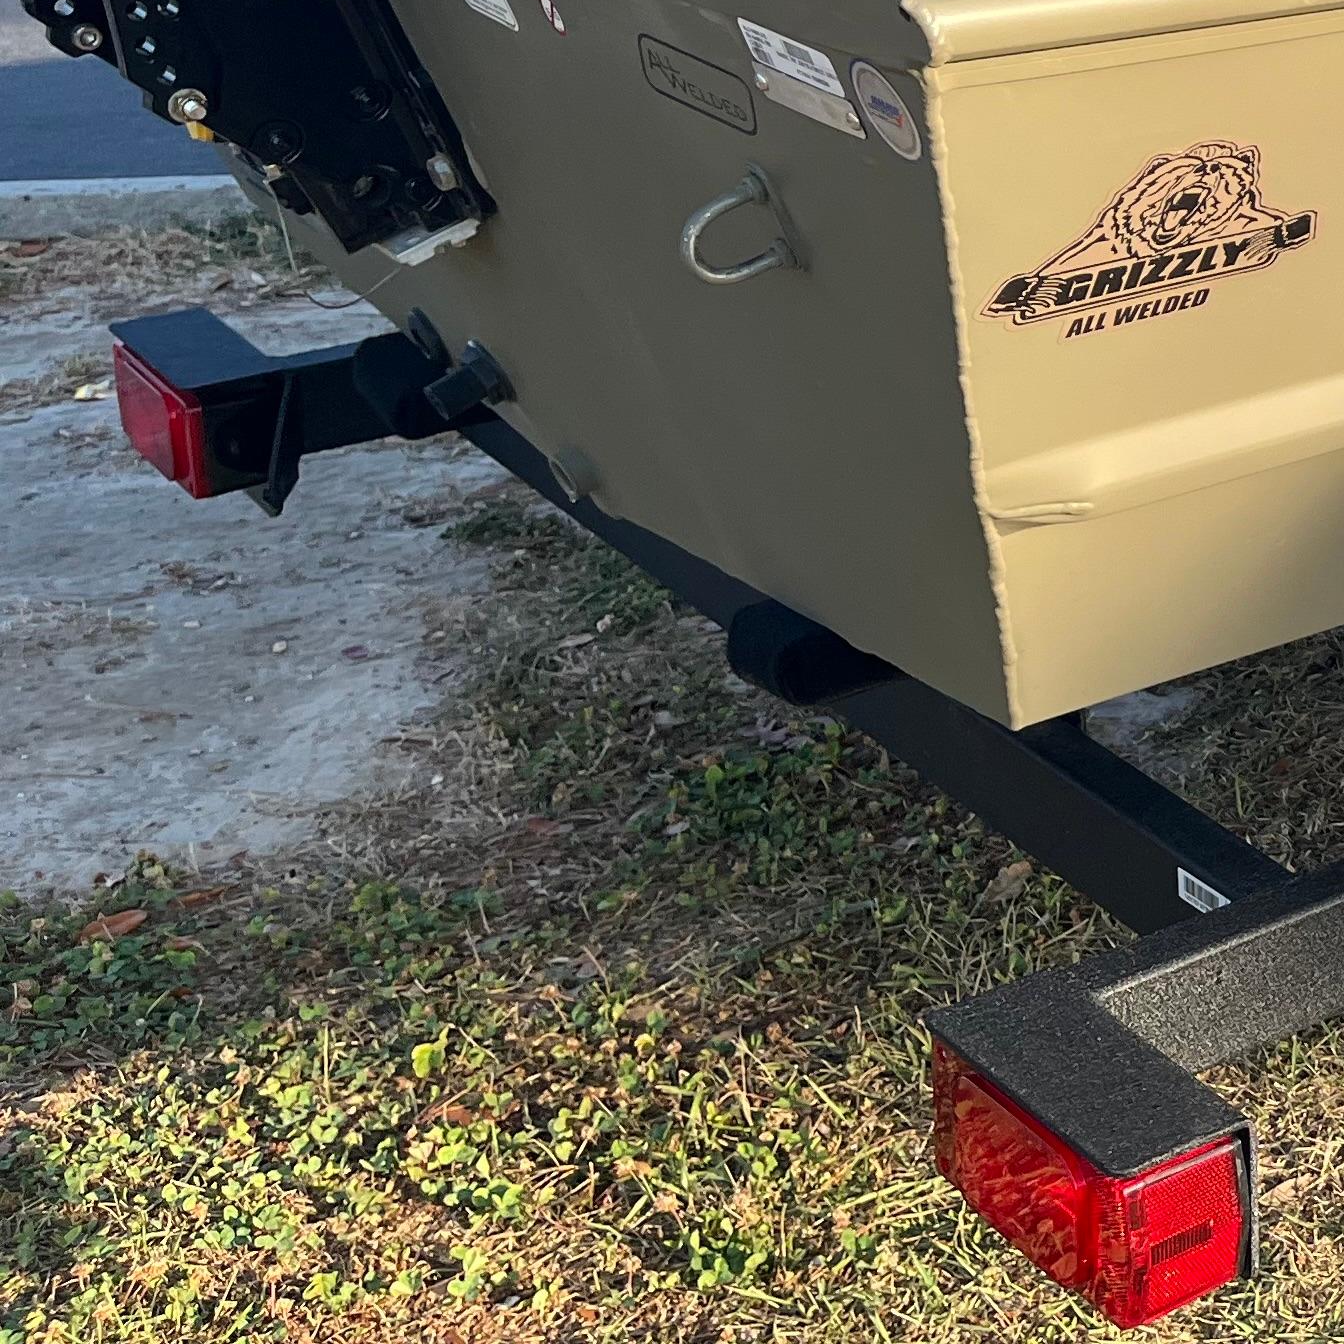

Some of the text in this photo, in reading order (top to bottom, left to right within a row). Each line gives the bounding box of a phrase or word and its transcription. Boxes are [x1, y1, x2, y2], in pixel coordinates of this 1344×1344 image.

[1052, 237, 1253, 306] GRIZZLY
[1064, 287, 1211, 340] ALL WELDED
